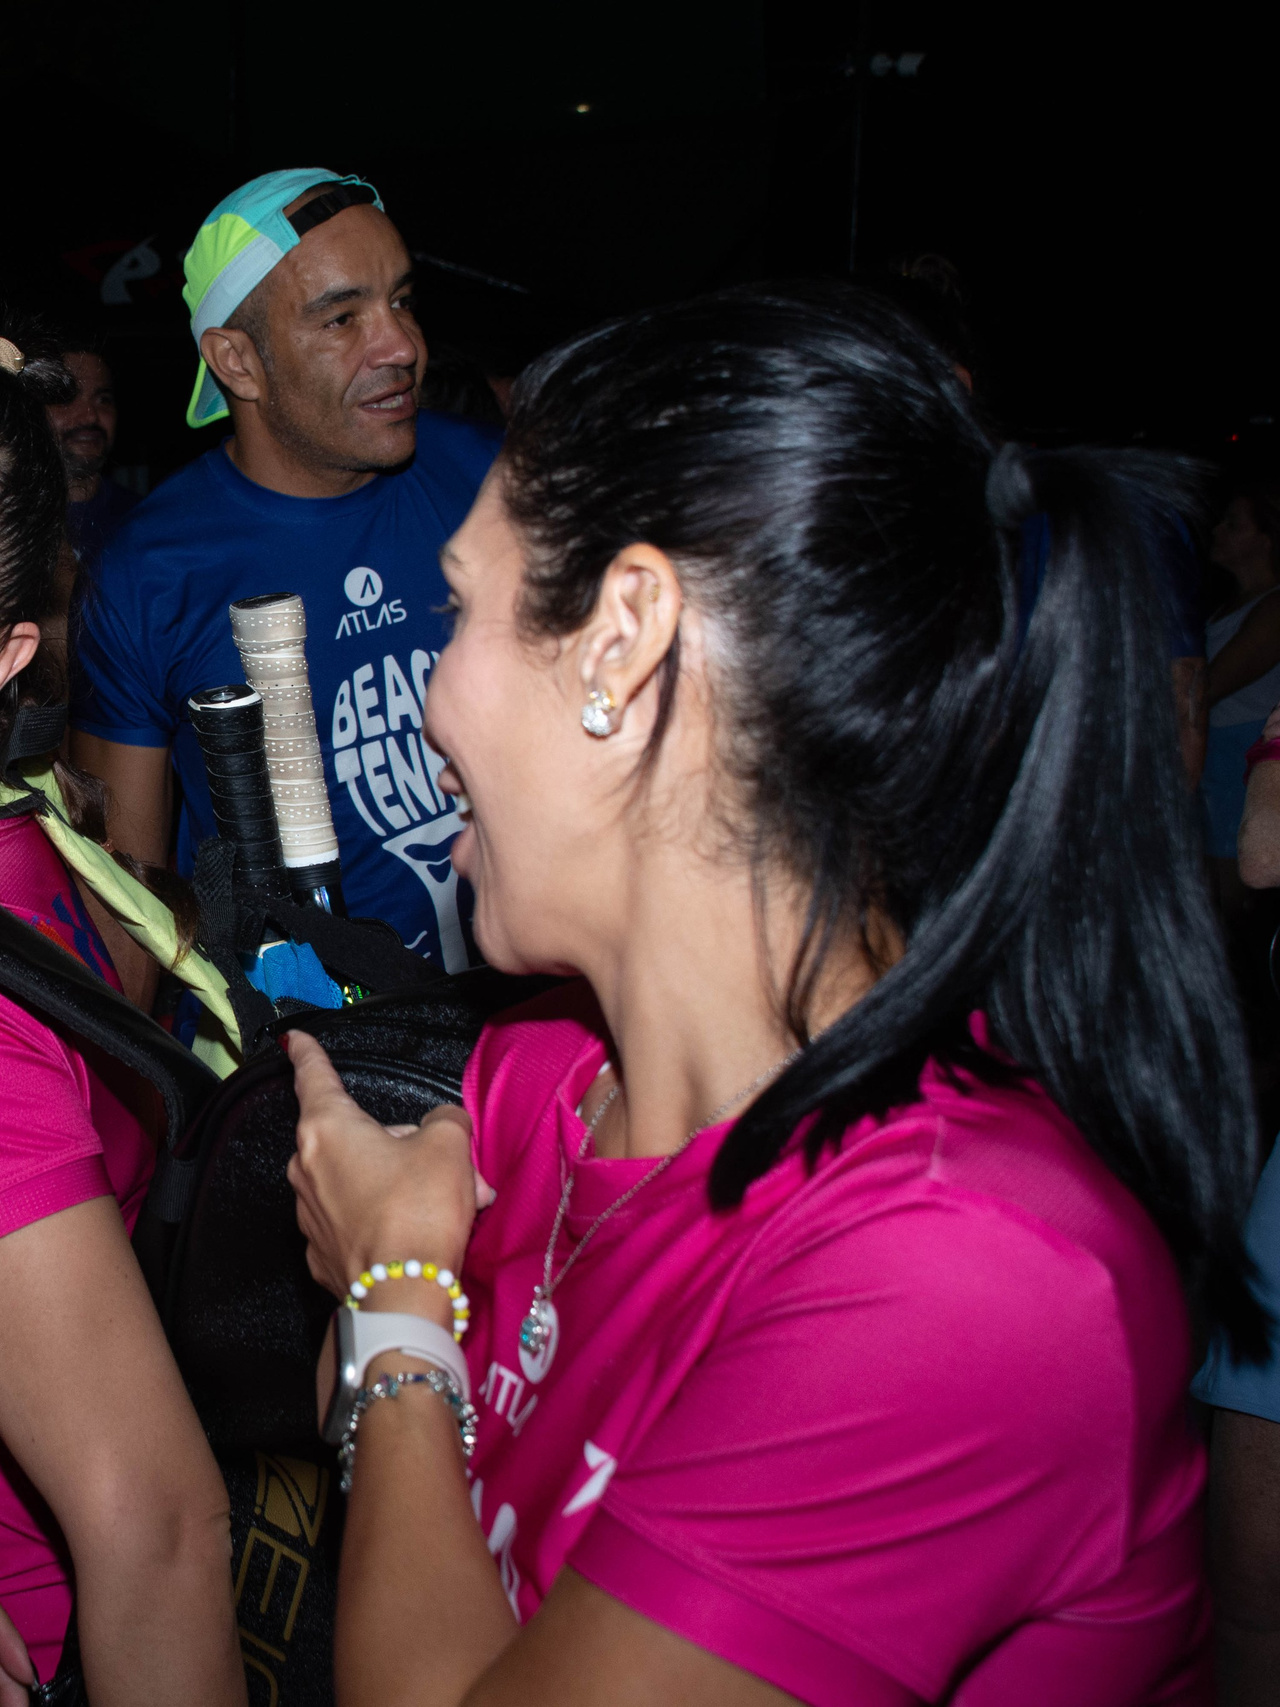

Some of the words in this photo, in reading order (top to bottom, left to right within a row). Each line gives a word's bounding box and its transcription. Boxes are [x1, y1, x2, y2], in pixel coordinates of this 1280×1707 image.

[335, 598, 407, 640] ATLAS
[332, 649, 442, 750] BEAC
[334, 732, 458, 836] TENN
[477, 1360, 540, 1438] ATLA
